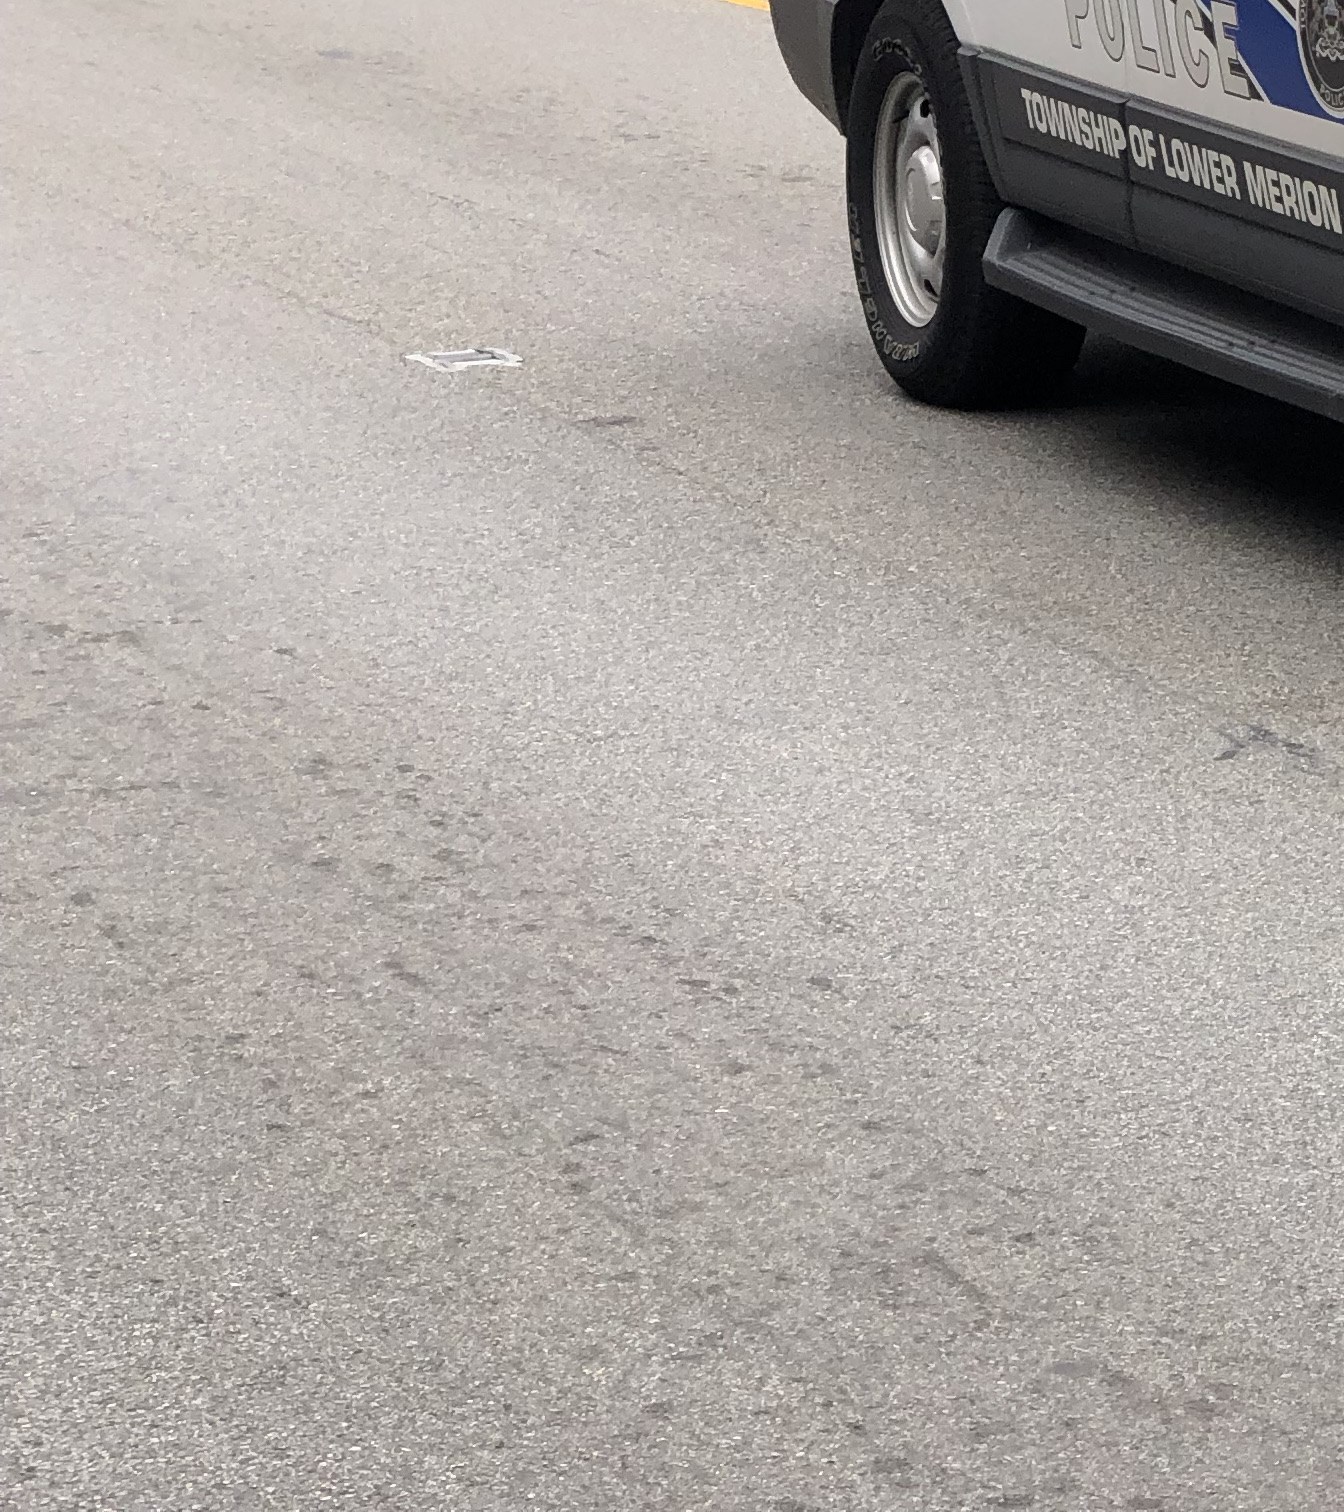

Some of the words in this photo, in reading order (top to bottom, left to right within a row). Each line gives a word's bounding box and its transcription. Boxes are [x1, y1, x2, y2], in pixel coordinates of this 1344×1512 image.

[1021, 88, 1126, 159] TOWNSHIP
[1129, 125, 1156, 170] OF
[1159, 133, 1241, 200] LOWER
[1243, 160, 1343, 234] MERION
